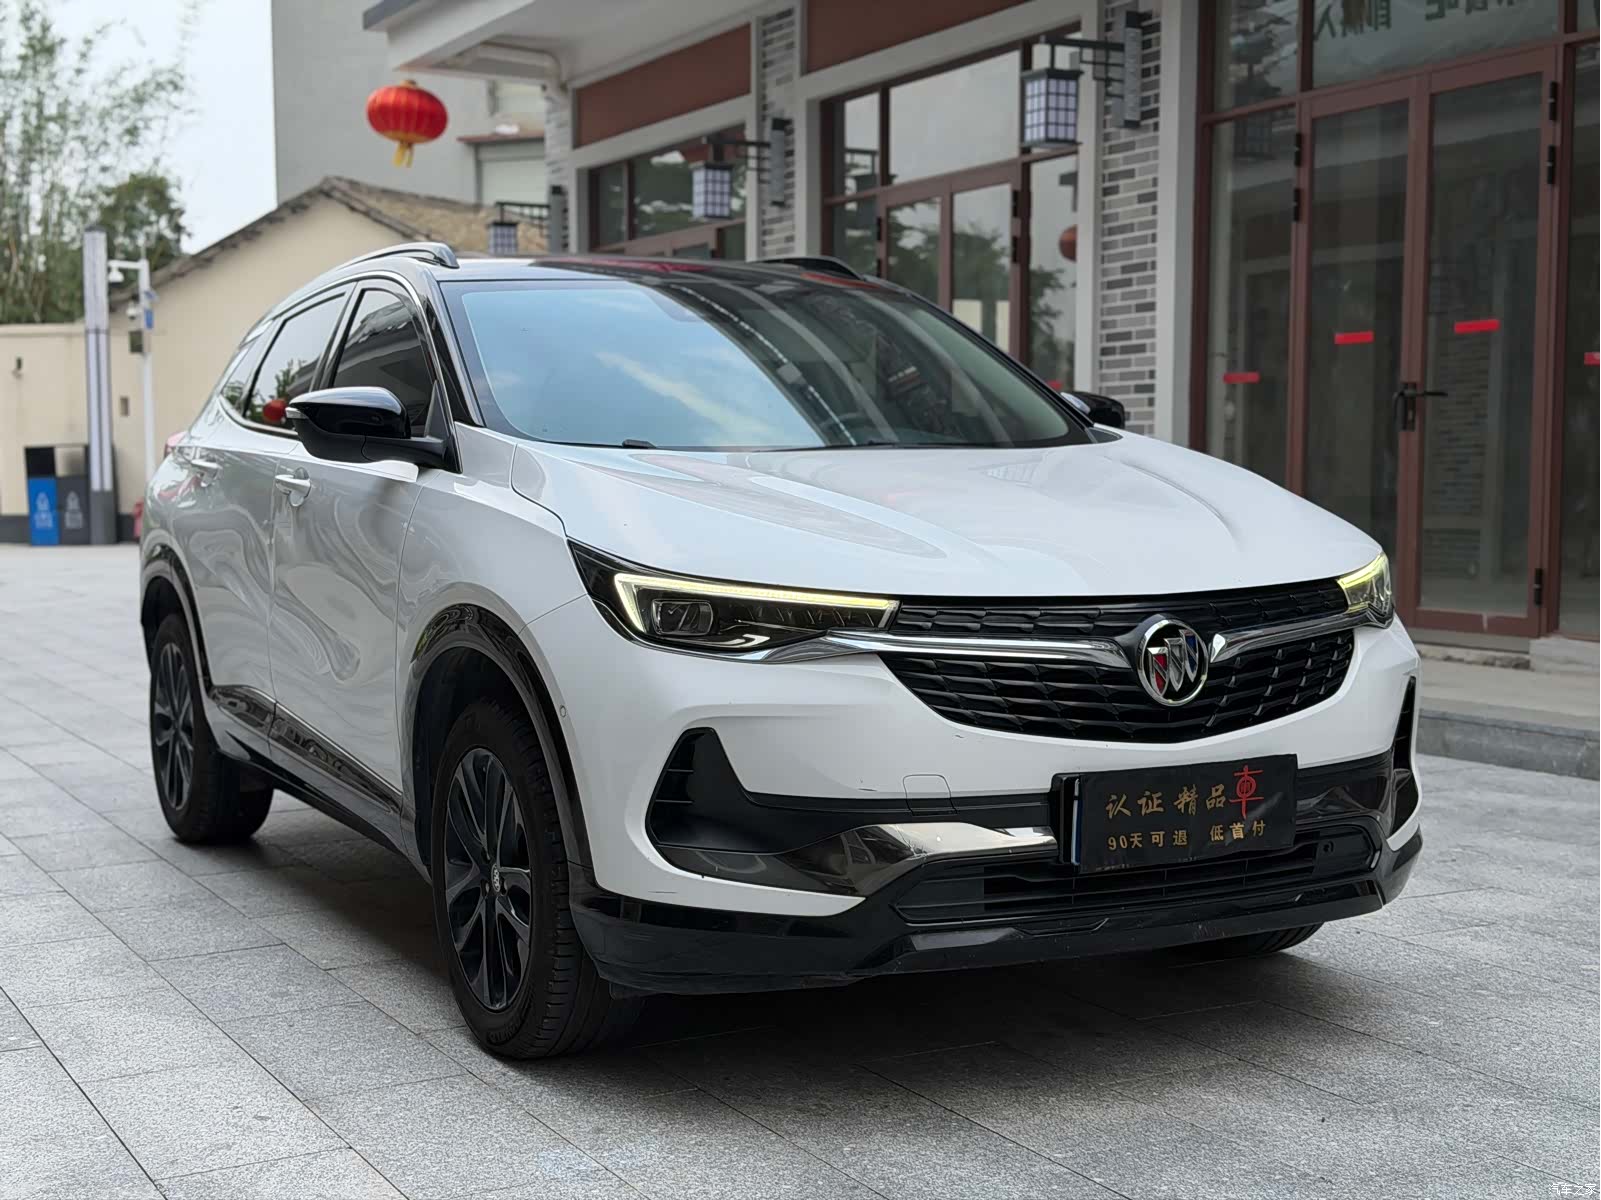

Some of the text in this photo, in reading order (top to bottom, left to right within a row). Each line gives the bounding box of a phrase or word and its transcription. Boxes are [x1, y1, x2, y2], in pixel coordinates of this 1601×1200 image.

[1107, 819, 1266, 851] 90天可退 低首付
